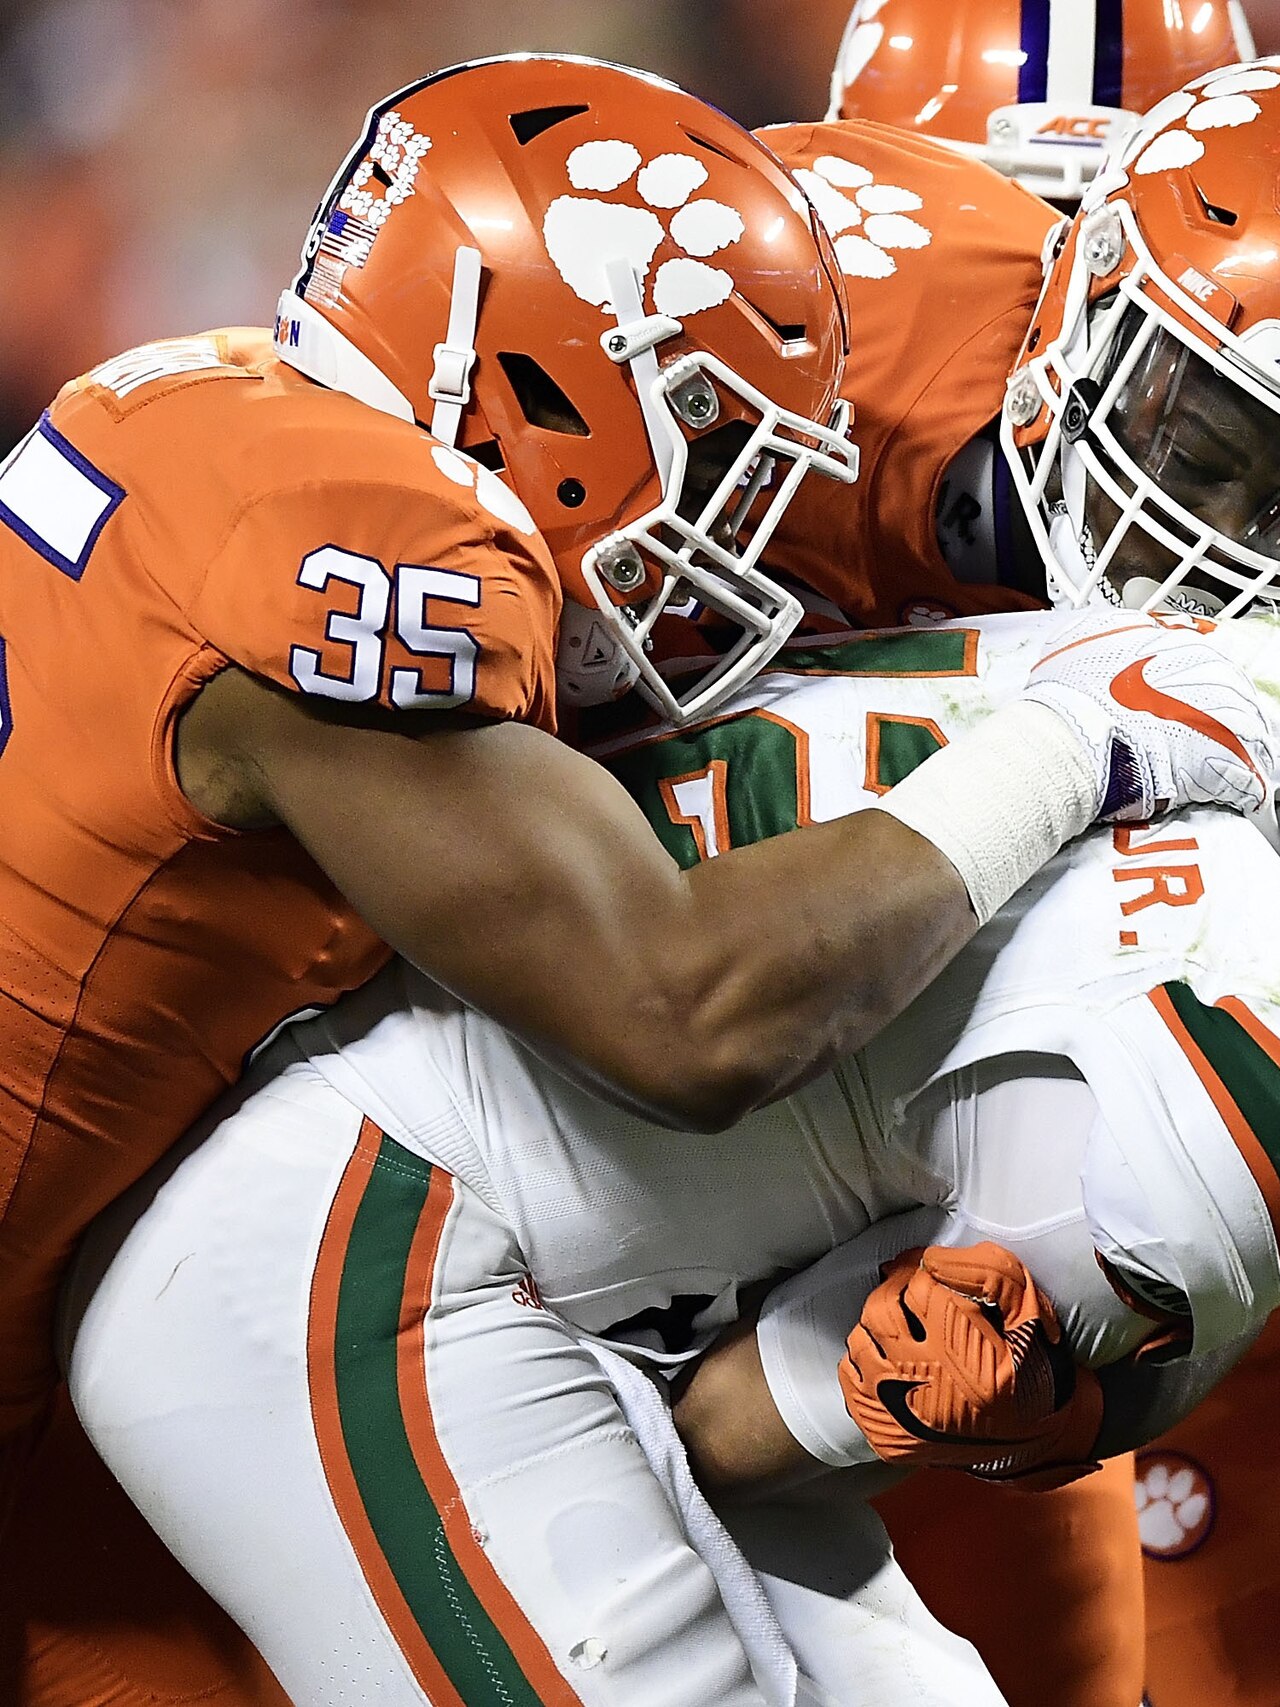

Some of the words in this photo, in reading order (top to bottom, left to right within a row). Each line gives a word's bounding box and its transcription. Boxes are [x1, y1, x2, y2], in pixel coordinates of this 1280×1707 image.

[1038, 116, 1111, 139] ACC
[1176, 266, 1220, 303] NIKE
[288, 542, 482, 710] 35
[1112, 820, 1205, 946] JR.
